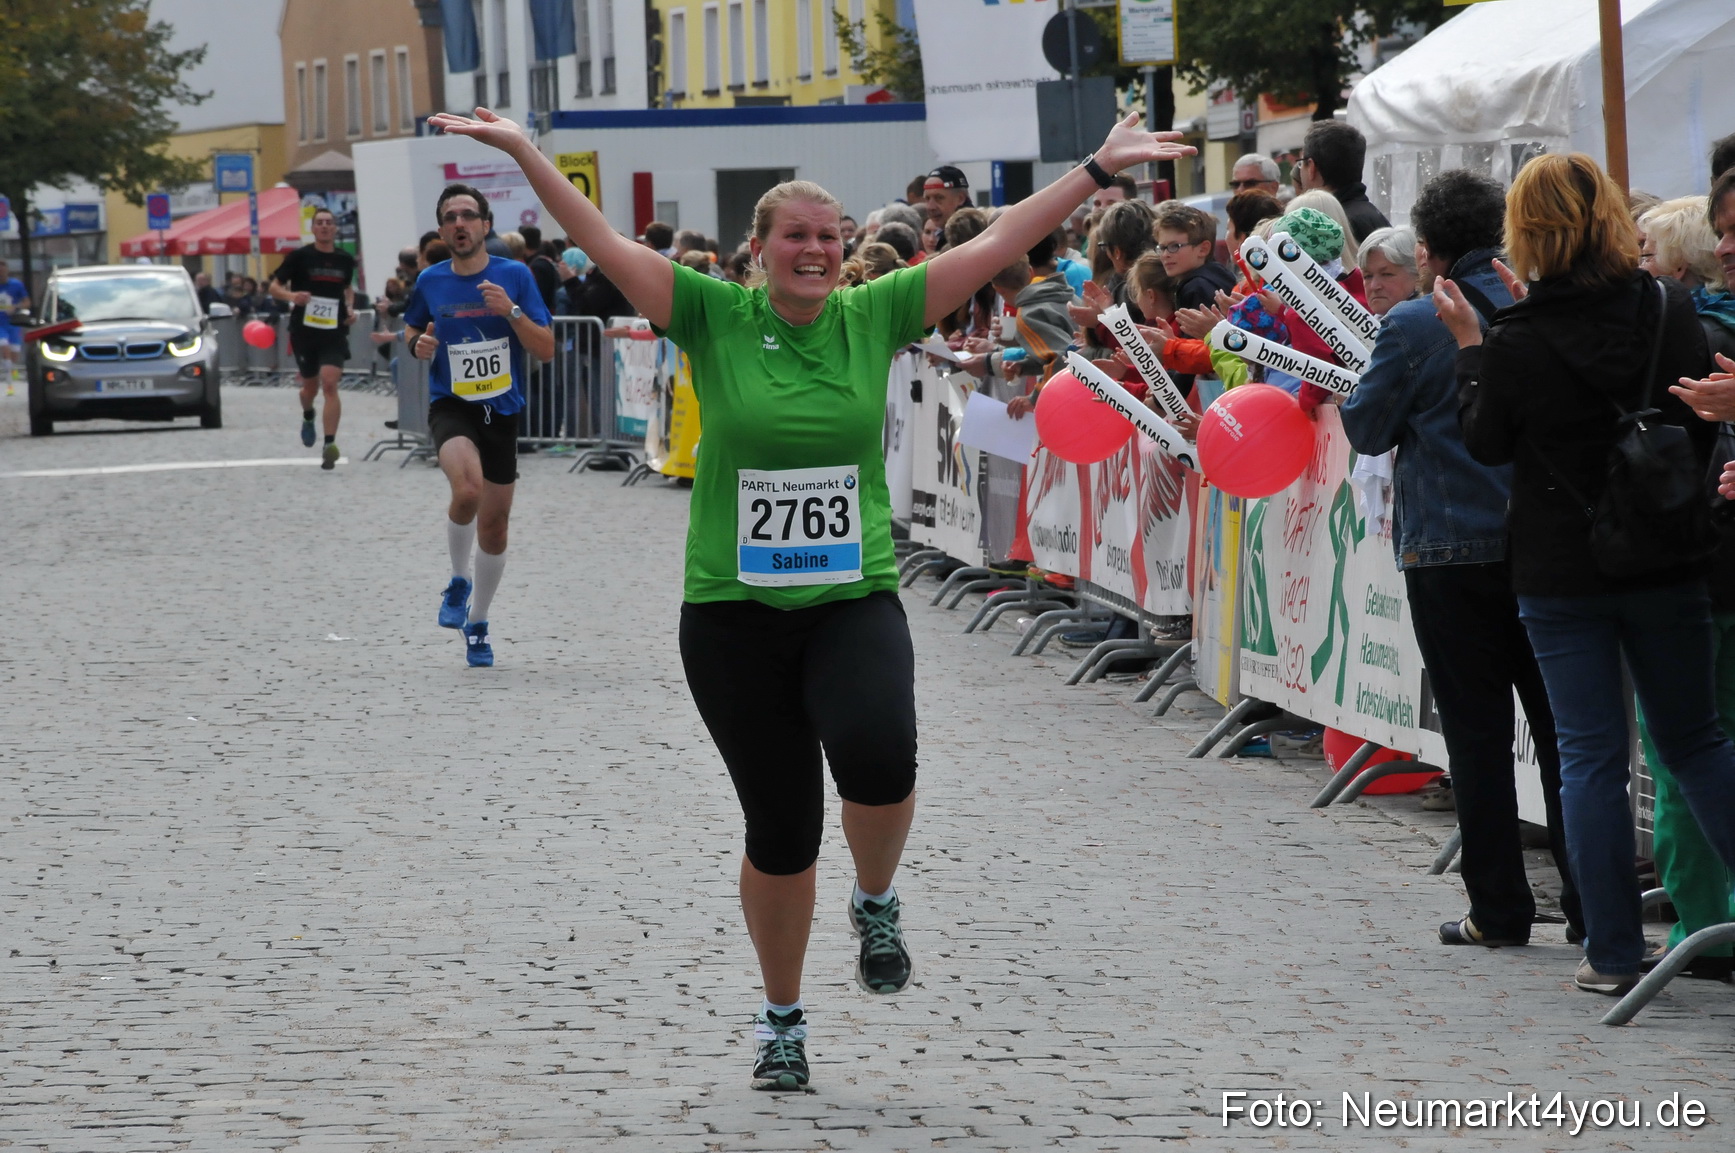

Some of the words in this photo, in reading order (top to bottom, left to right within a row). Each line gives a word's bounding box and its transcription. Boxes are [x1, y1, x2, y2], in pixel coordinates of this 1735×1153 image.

[560, 154, 594, 168] Block
[313, 304, 332, 318] 221
[471, 345, 500, 355] Neumarkt
[462, 354, 501, 379] 206
[475, 382, 493, 392] Karl
[741, 480, 780, 492] PARTL
[782, 479, 840, 492] Neumarkt
[751, 495, 850, 541] 2763
[772, 552, 829, 570] Sabine
